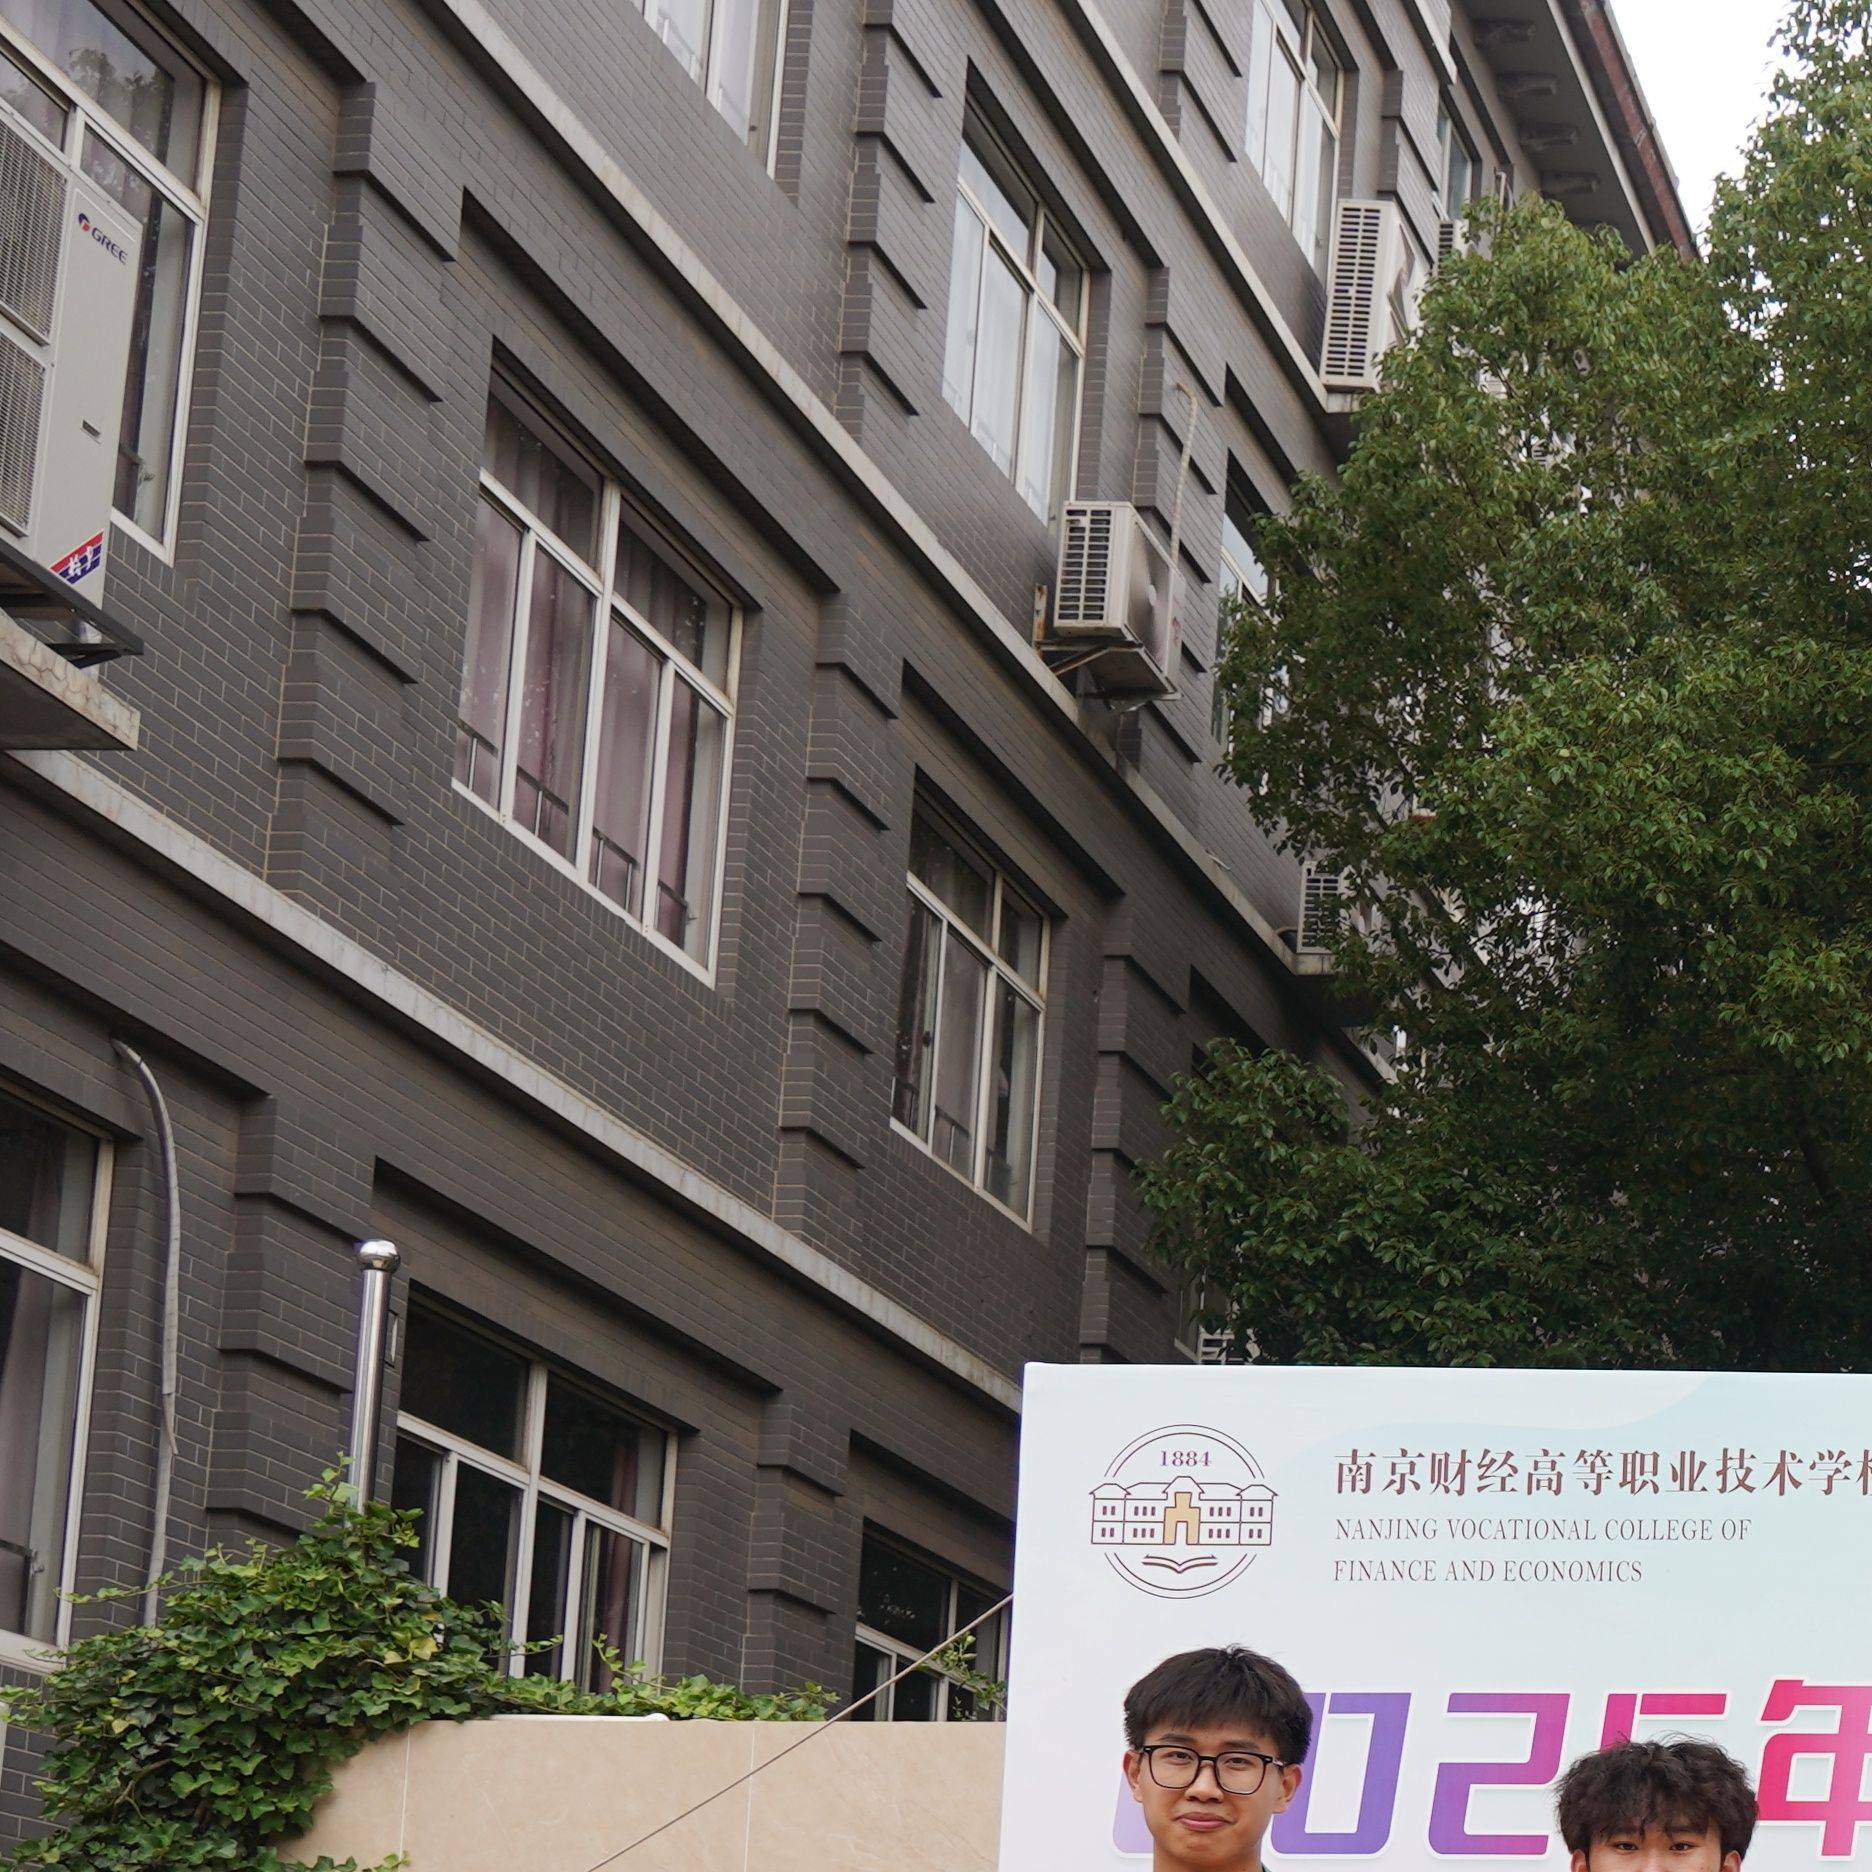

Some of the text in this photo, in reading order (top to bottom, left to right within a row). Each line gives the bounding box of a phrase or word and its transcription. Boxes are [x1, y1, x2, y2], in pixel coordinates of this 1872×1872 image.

[91, 227, 128, 266] GREE
[1159, 1450, 1211, 1468] 1884
[1335, 1517, 1752, 1542] NANJING VOCATIONAL COLLEGE OF
[1333, 1558, 1642, 1584] FINANCE AND ECONOMICS
